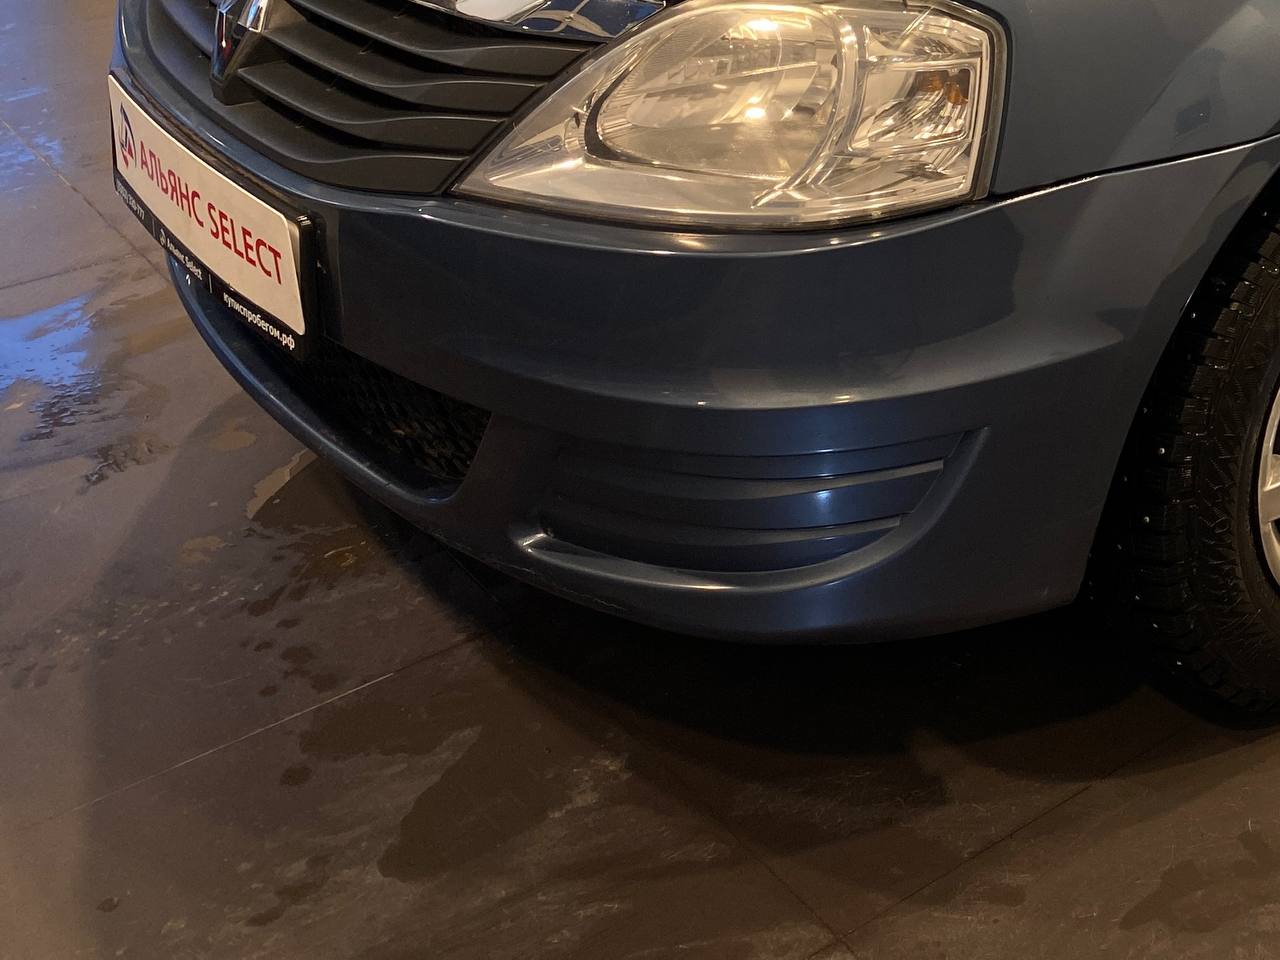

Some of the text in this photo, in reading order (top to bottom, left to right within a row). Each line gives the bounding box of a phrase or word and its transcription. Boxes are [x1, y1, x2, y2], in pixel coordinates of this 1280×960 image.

[140, 140, 205, 228] АЛЬЯНС
[207, 202, 283, 285] SELECT
[223, 292, 296, 351] куписпробегом.рф
